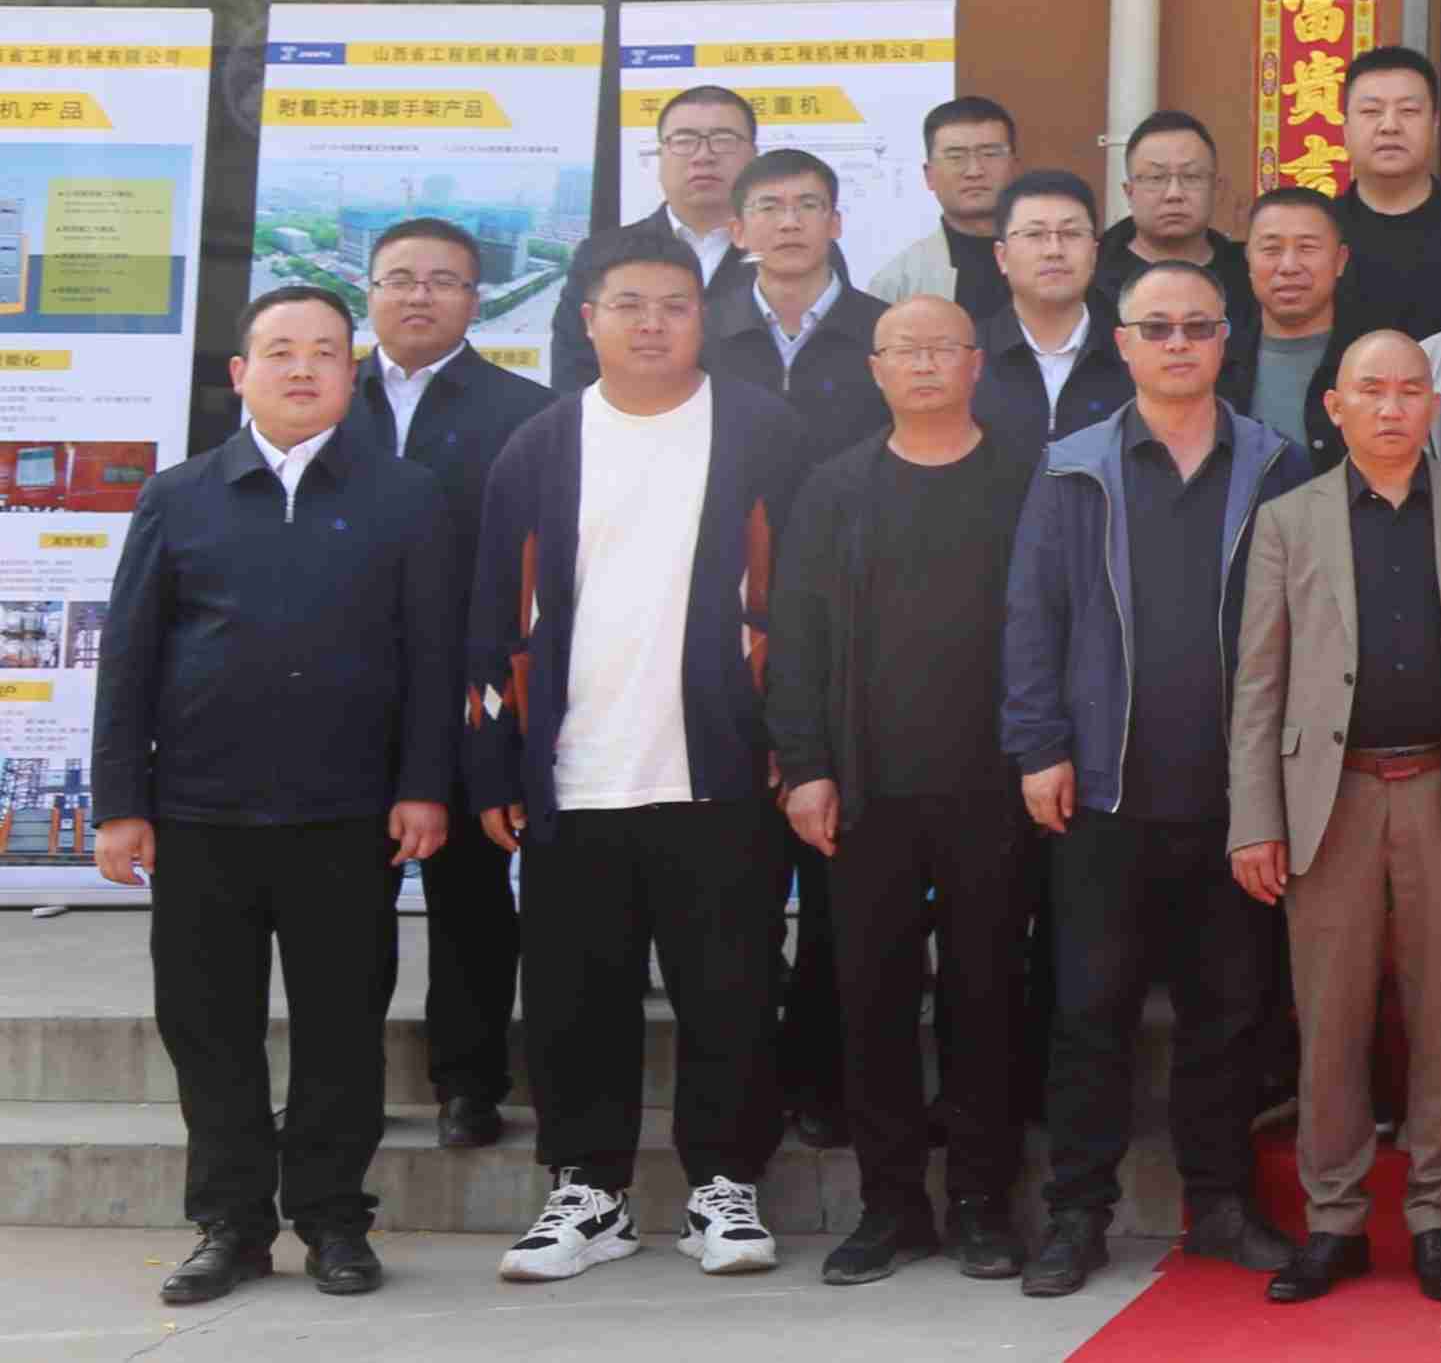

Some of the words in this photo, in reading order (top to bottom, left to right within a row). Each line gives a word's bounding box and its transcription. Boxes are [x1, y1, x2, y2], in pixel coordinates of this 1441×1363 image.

[372, 45, 577, 63] 山西省工程机械有限公司
[723, 42, 926, 63] 山西省工程机械有限公司
[278, 97, 484, 120] 附着式升降脚手架产品
